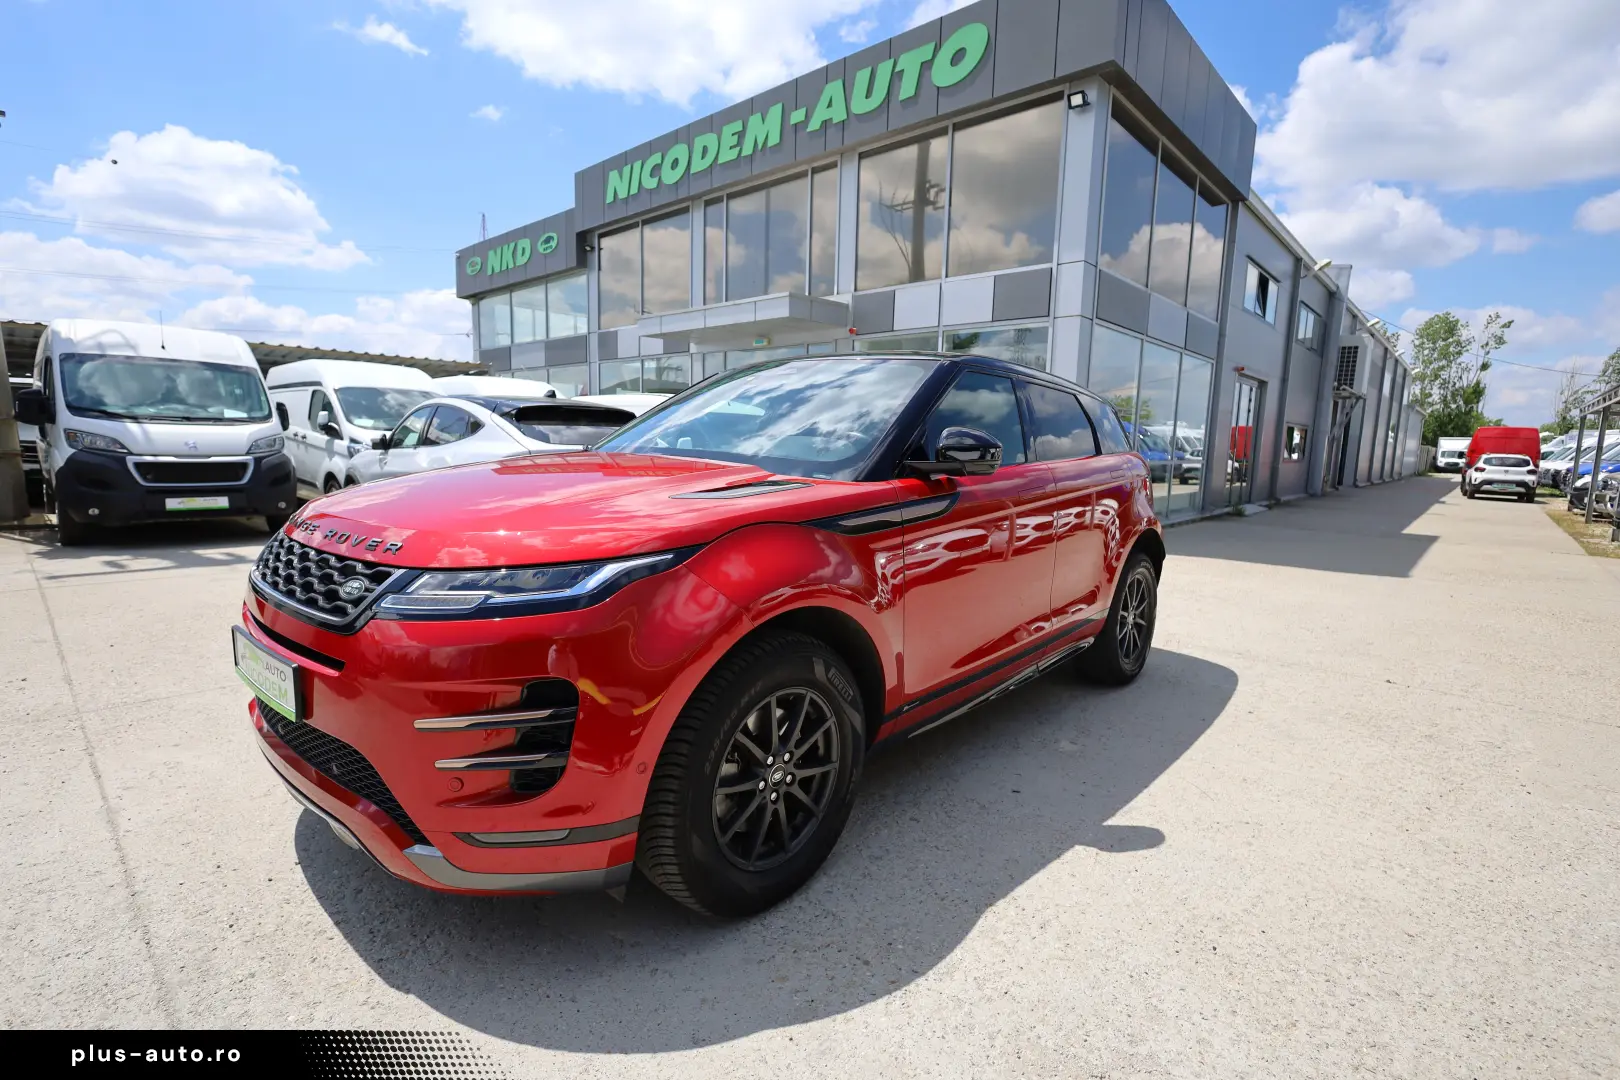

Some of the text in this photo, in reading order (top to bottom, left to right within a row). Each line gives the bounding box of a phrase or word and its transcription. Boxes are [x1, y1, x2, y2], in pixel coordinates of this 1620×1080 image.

[487, 238, 531, 276] NKD
[323, 528, 404, 556] ROVER
[264, 661, 287, 682] AUTO
[827, 666, 854, 702] PIRELLI
